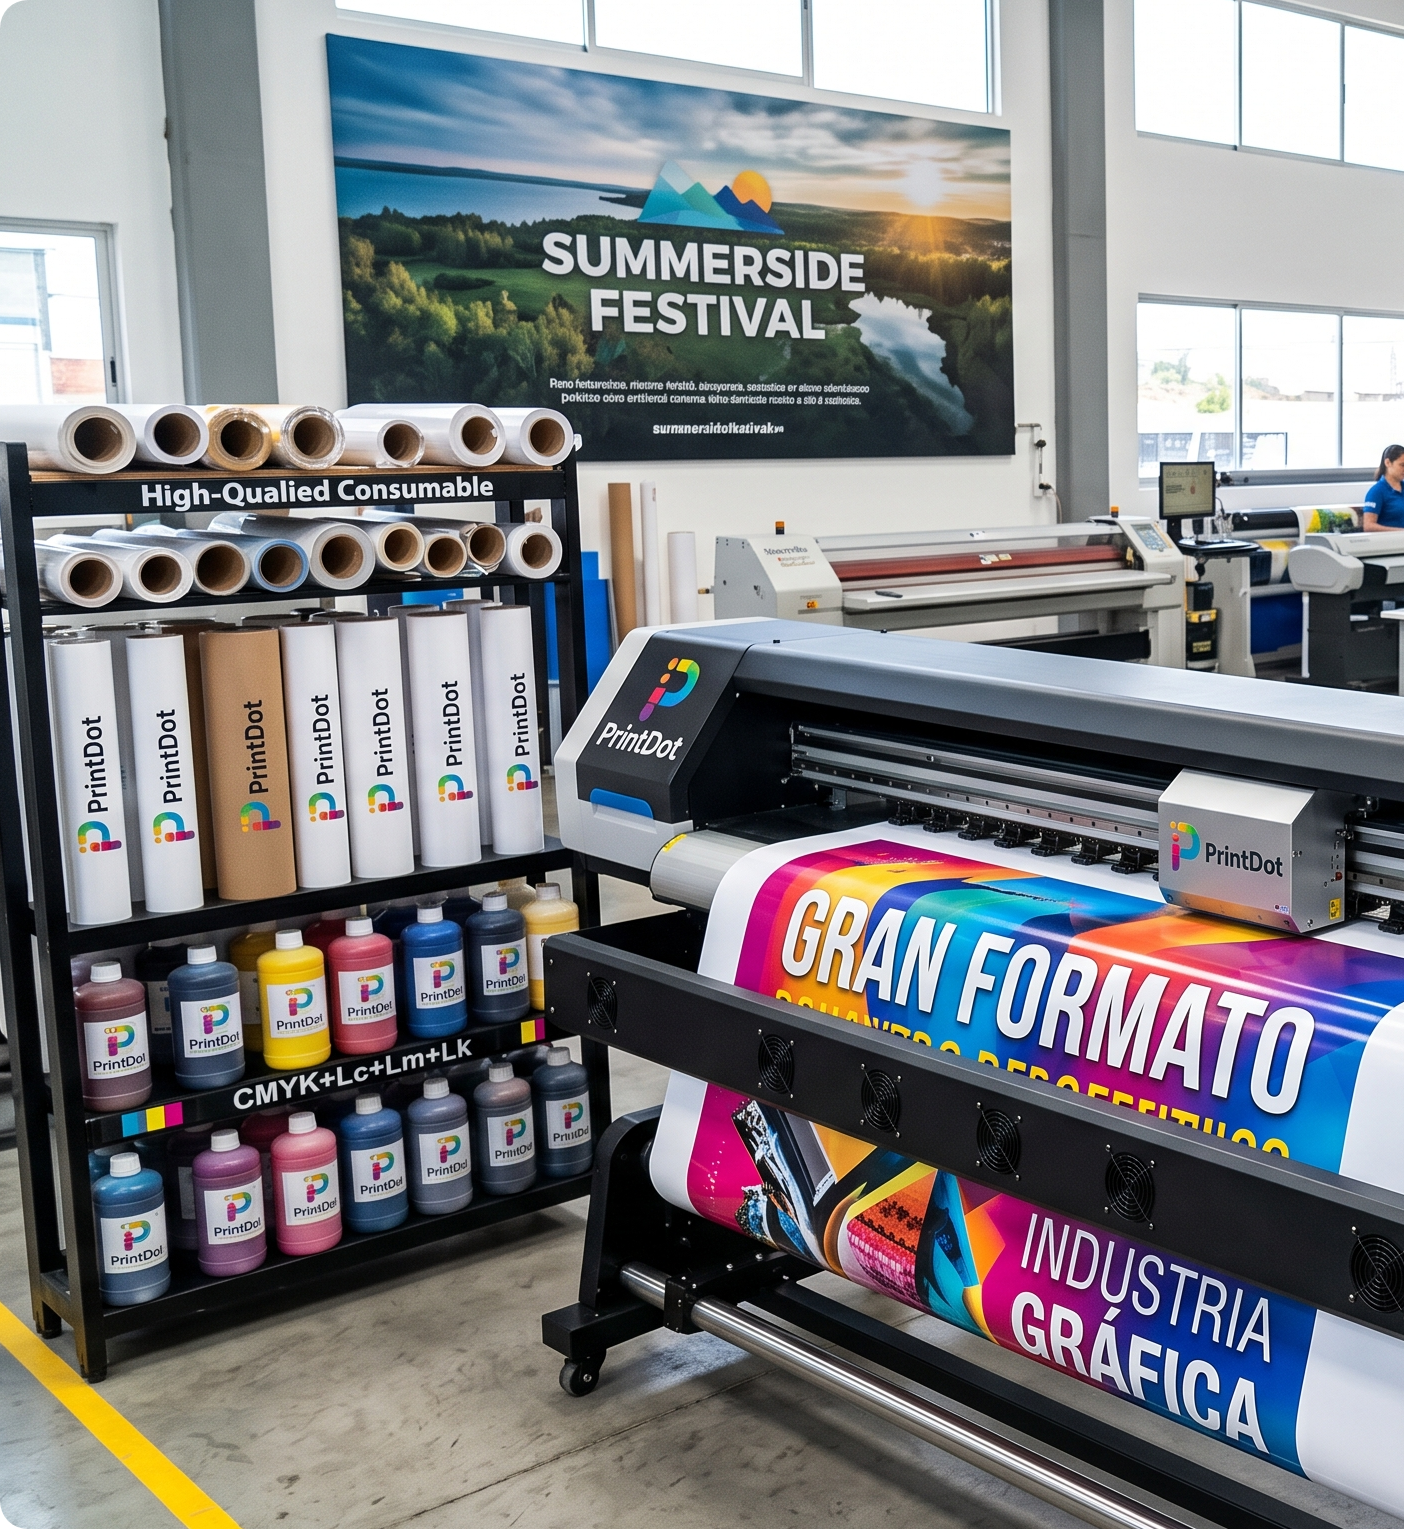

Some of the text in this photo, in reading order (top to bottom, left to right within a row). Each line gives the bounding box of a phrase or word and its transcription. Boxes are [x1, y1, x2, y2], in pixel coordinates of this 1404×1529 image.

[542, 232, 865, 291] SUMMERSIDE
[590, 287, 826, 340] FESTIVAL
[141, 476, 494, 511] High-Qualied Consumable
[156, 708, 184, 804] PrintDot
[243, 699, 269, 795] PrintDot
[311, 693, 334, 786] PrintDot
[371, 687, 394, 778] PrintDot
[441, 680, 463, 768] PrintDot
[510, 672, 530, 757] PrintDot
[595, 721, 684, 761] PrintDot
[81, 715, 108, 814] PrintDot
[1205, 842, 1284, 877] PrintDot
[780, 888, 957, 1013] GRAN
[955, 930, 1317, 1116] FORMATO
[1020, 1211, 1271, 1364] INDUSTRIA
[1010, 1291, 1271, 1454] GRÁFICA
